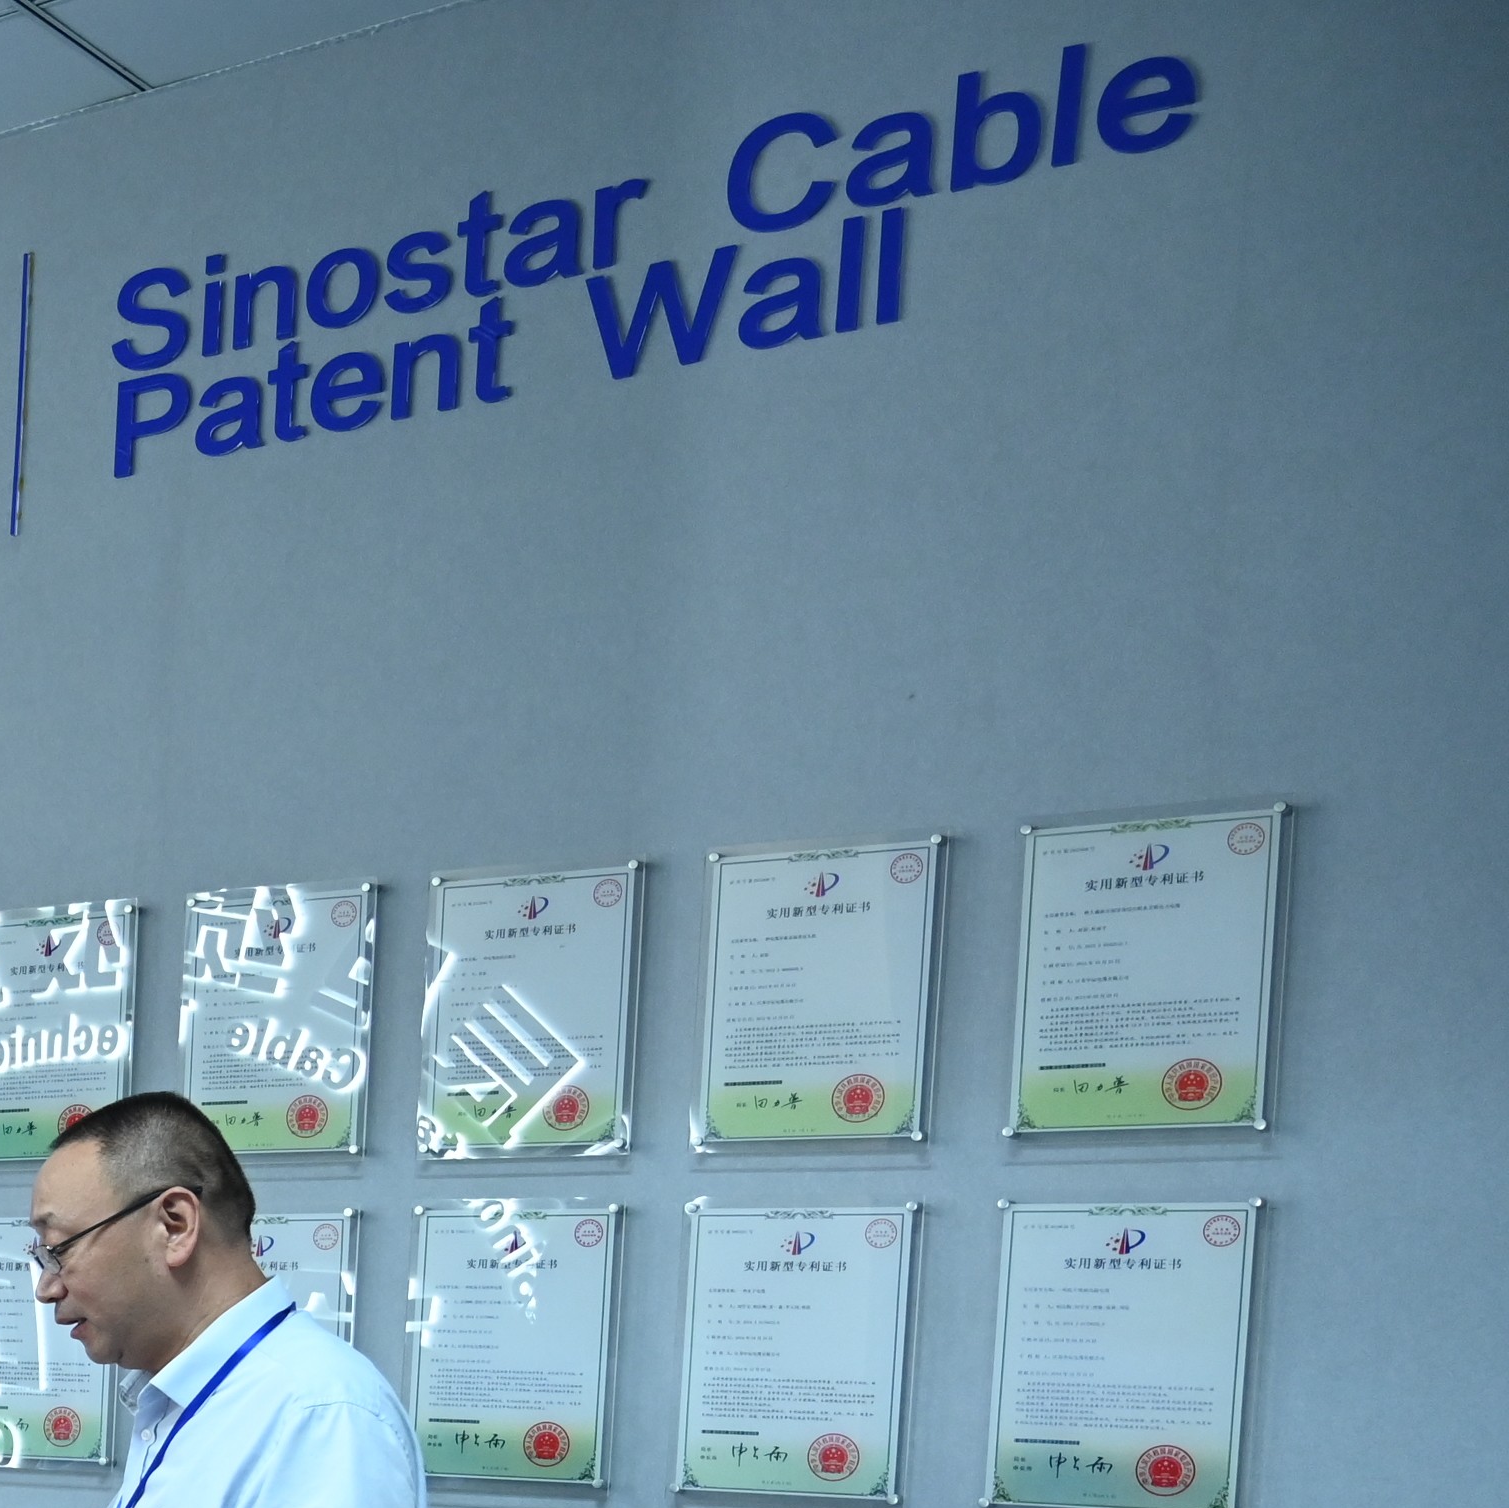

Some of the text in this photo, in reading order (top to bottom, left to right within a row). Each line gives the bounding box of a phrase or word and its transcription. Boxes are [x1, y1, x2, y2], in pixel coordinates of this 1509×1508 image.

[114, 44, 1198, 374] Sinostar Cable
[113, 207, 906, 477] Patent Wall
[1085, 870, 1205, 892] 实用新型专利证书
[766, 901, 871, 921] 实用新型专利证书
[484, 923, 577, 941] 实用新型专利证书
[10, 961, 85, 976] 实用新型专利书
[744, 1258, 847, 1274] 实用新型专利证书
[1064, 1257, 1182, 1271] 实用新型专利证书
